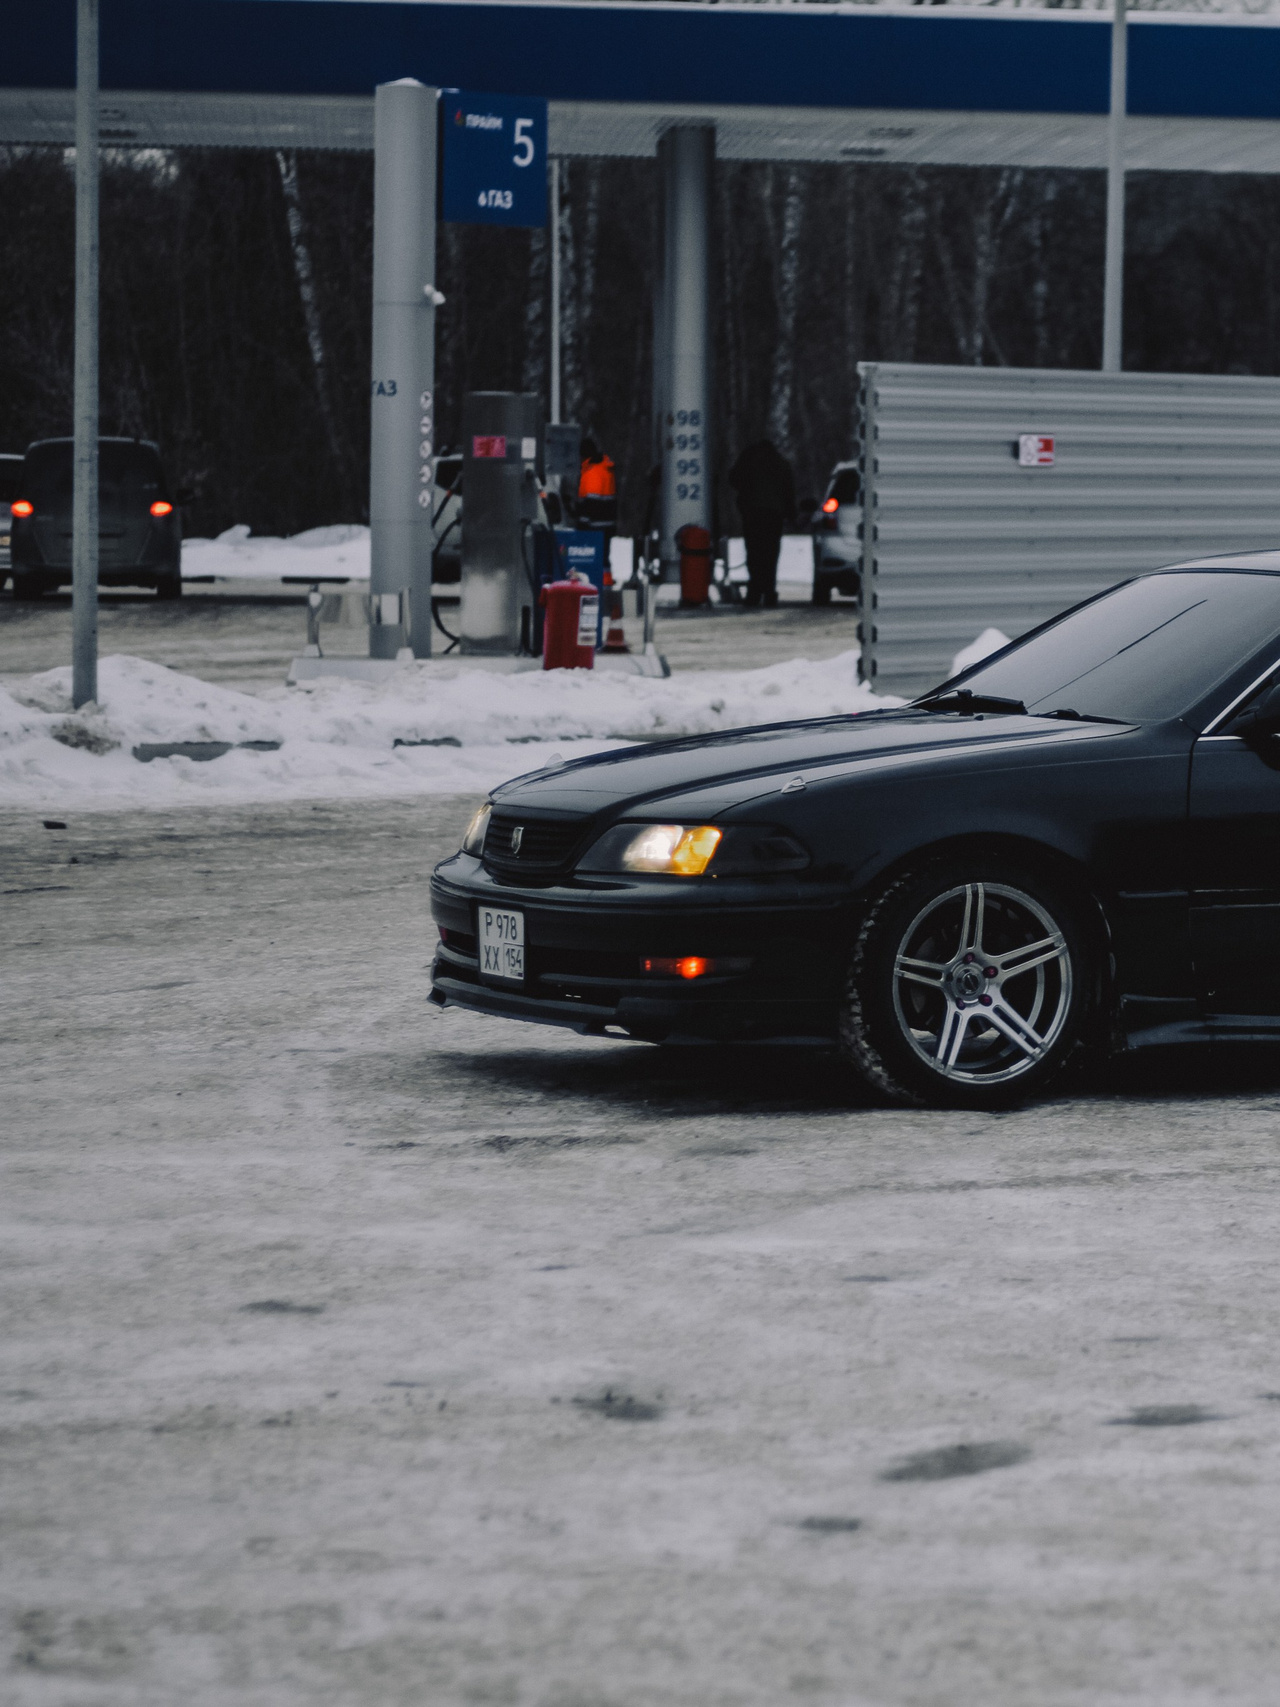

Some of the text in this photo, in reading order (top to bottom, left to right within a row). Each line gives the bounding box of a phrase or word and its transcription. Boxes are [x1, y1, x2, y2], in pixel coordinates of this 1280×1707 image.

[513, 117, 535, 167] 5
[488, 189, 514, 209] ГАЗ
[677, 409, 700, 426] 98
[677, 433, 700, 451] 95
[677, 458, 700, 476] 95
[677, 483, 700, 501] 92
[496, 914, 518, 941] 978
[505, 948, 521, 969] 154
